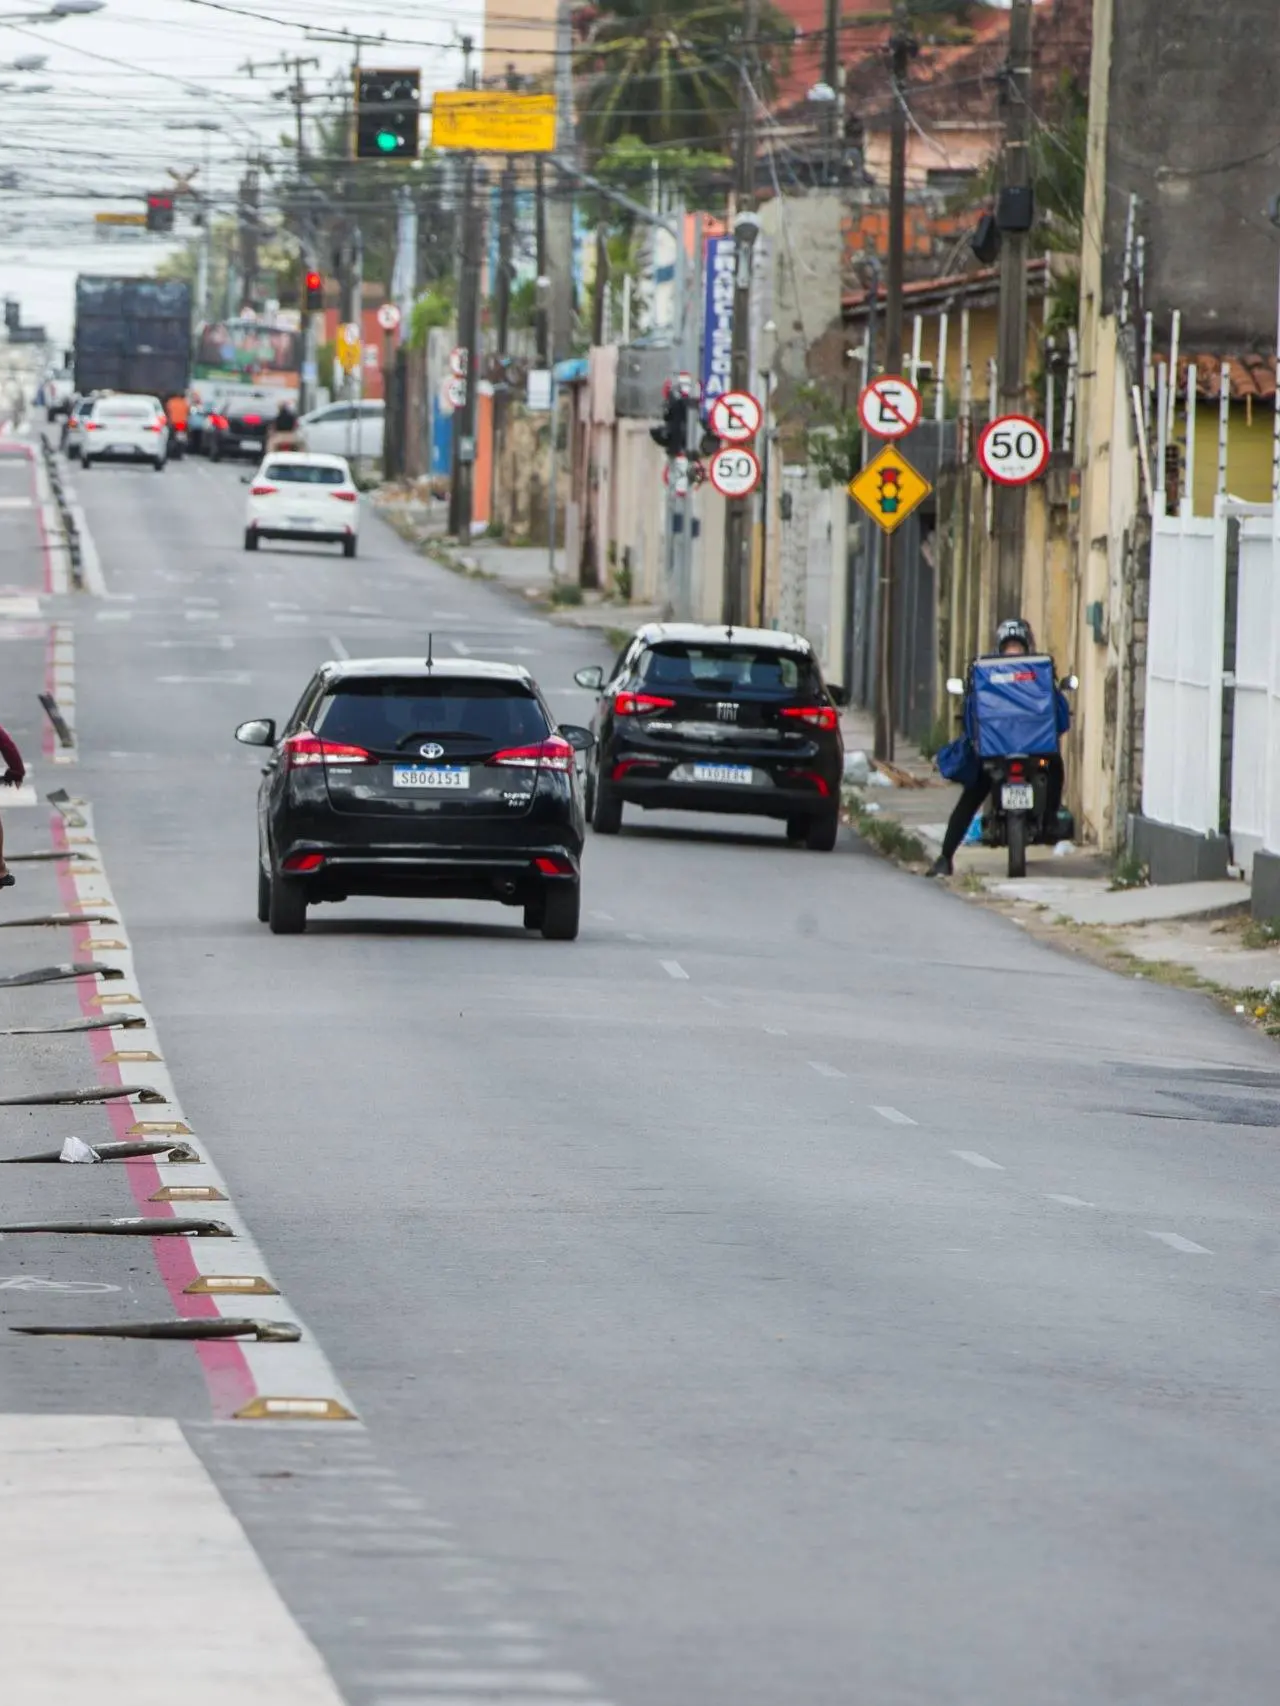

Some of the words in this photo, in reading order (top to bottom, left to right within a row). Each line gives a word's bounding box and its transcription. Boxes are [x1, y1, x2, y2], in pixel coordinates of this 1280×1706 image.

[728, 404, 745, 429] E
[878, 390, 902, 423] E
[991, 431, 1037, 460] 50
[718, 457, 751, 478] 50
